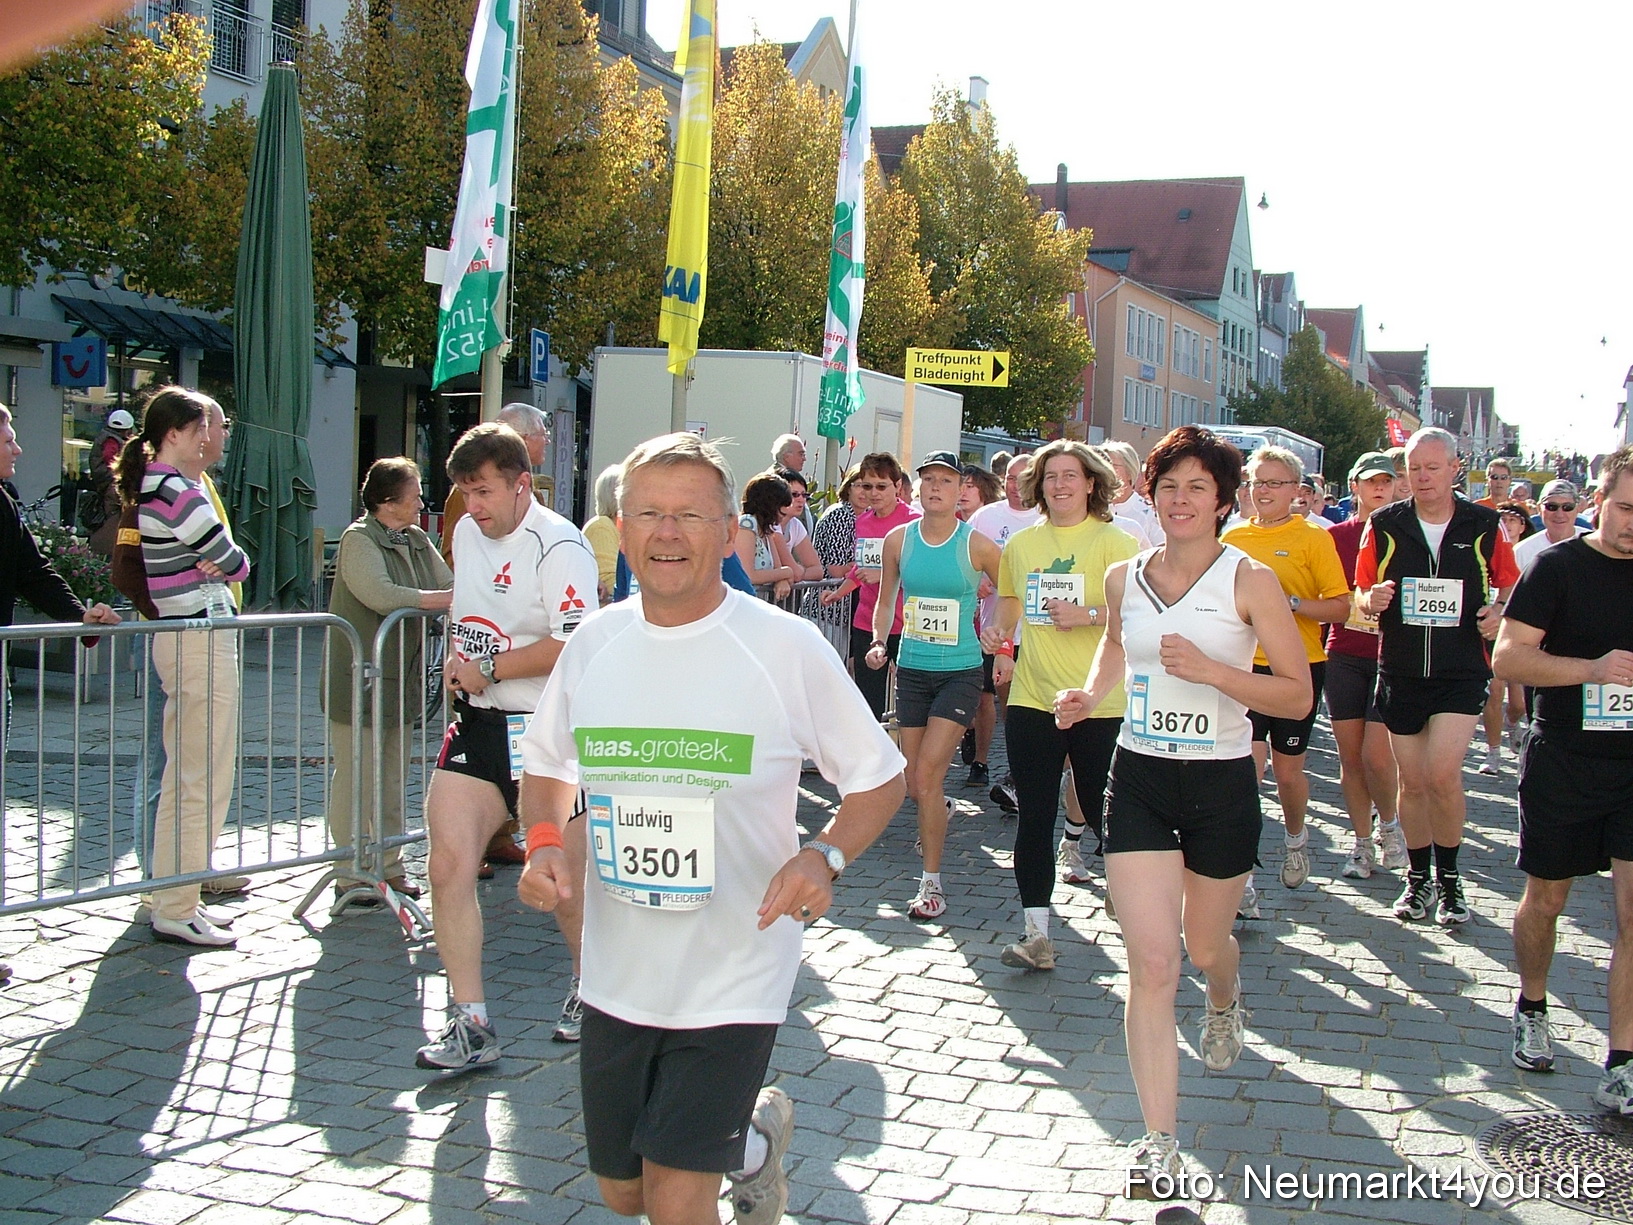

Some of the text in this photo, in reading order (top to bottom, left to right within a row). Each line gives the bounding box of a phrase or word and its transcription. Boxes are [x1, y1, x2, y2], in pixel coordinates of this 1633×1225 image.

[536, 337, 545, 374] P
[915, 352, 982, 367] Treffpunkt
[914, 367, 985, 383] Bladenight
[1041, 578, 1074, 591] Ingeborg
[1418, 582, 1445, 593] Hubert
[918, 601, 948, 612] Vanessa
[1418, 599, 1457, 614] 2694
[922, 617, 948, 632] 211
[1151, 710, 1209, 735] 3670
[662, 773, 683, 784] und
[686, 774, 733, 791] Design.
[617, 805, 673, 833] Ludwig
[623, 845, 698, 879] 3501
